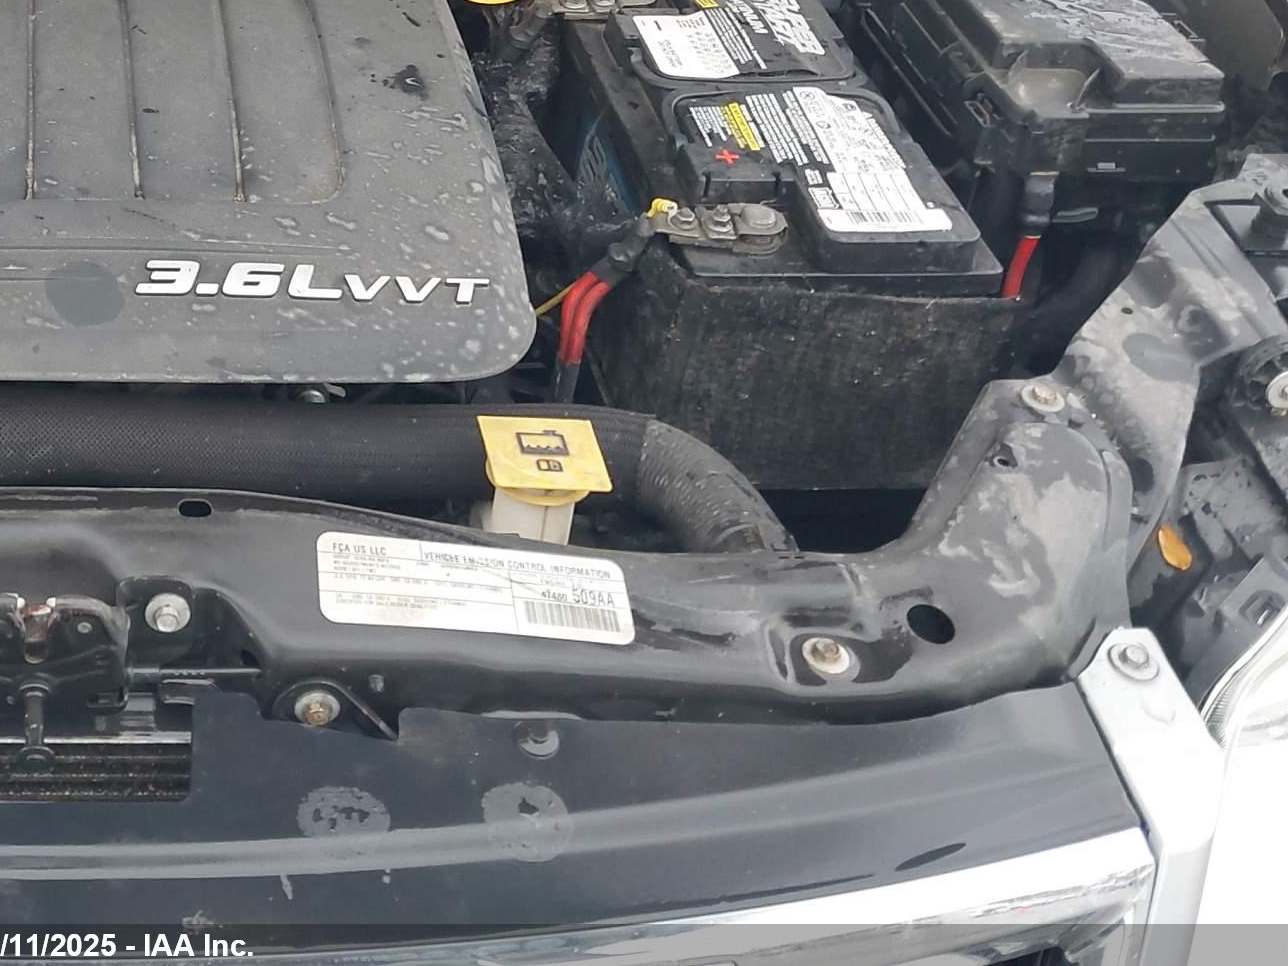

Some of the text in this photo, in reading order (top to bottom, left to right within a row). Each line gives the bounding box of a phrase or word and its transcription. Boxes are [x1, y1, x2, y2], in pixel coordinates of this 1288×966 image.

[136, 260, 490, 303] 3.6L VVT
[332, 542, 387, 556] FCA US LLC
[424, 552, 459, 562] VEHICLE
[464, 556, 504, 568] EMISSION
[508, 560, 546, 572] CONTROL
[550, 565, 610, 578] INFORMATION
